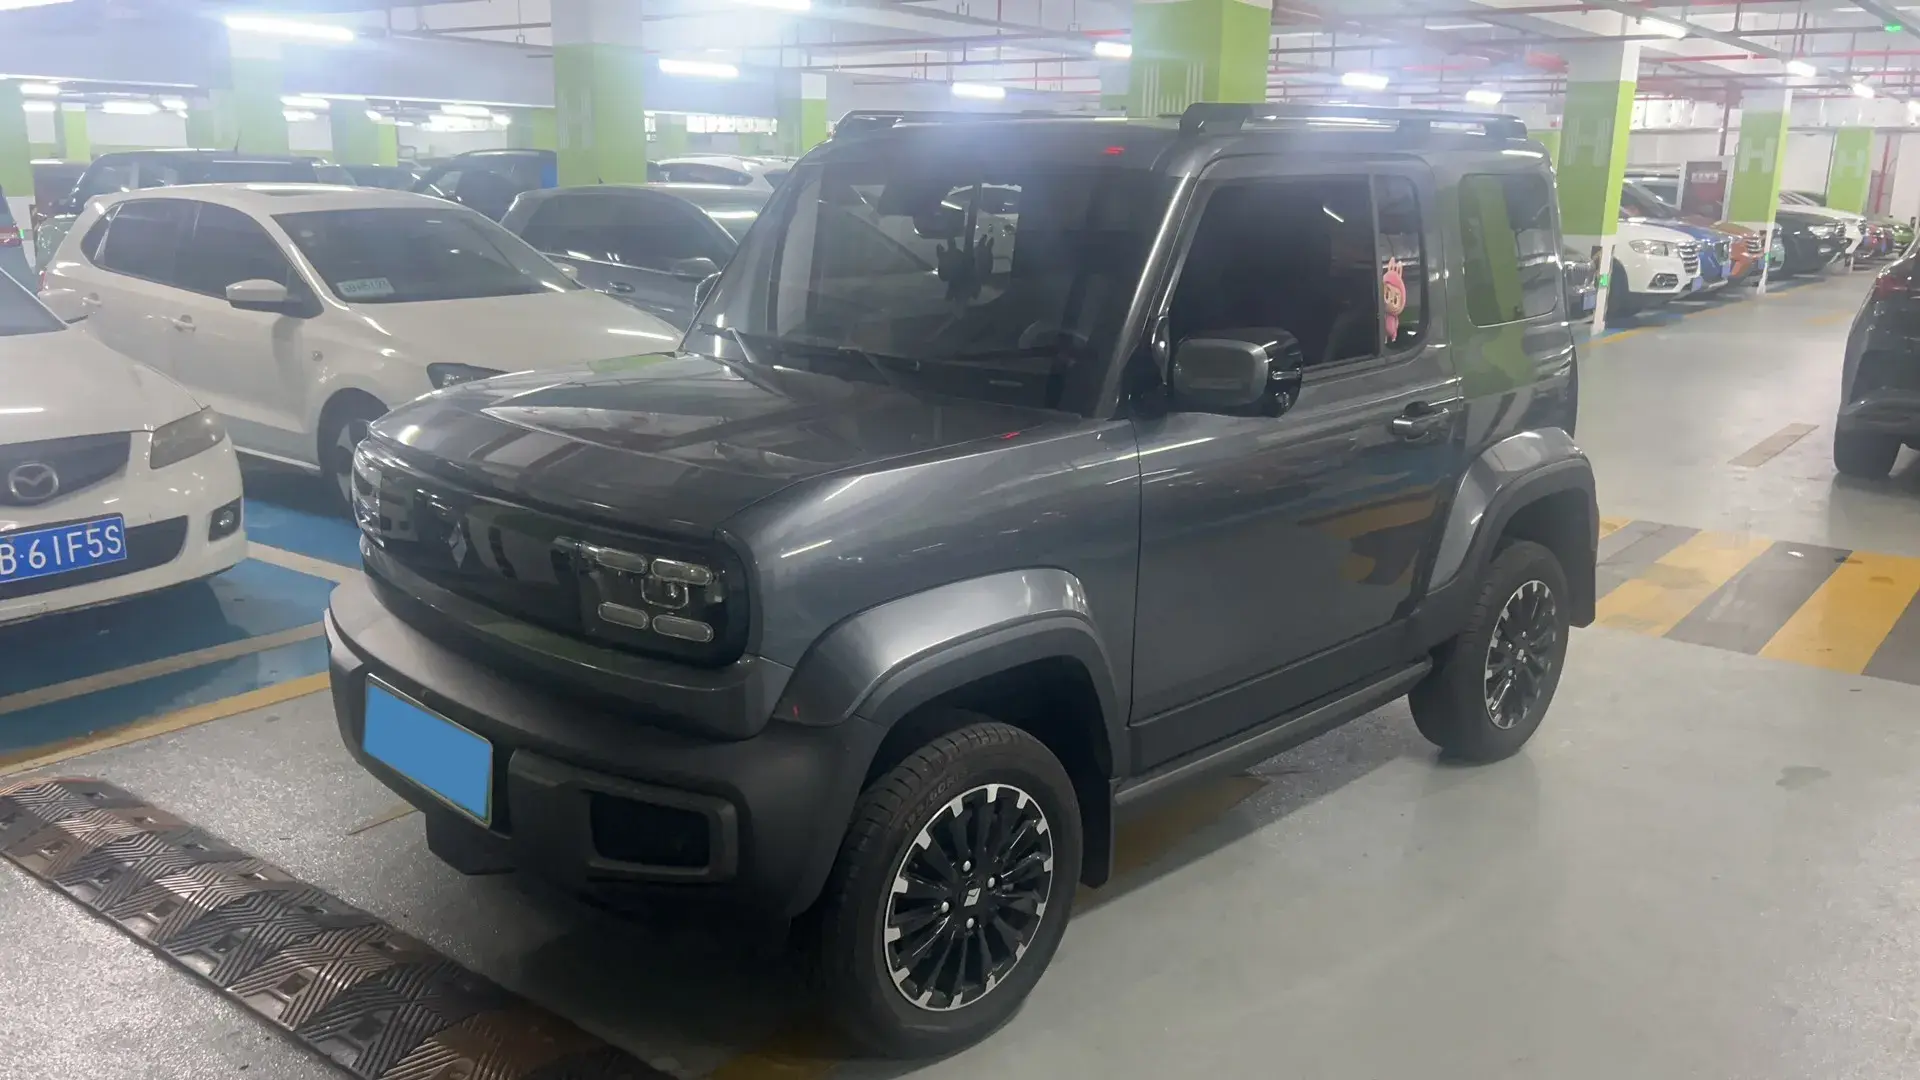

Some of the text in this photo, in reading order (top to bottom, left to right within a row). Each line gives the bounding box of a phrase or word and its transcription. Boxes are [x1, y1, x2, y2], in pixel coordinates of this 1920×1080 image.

[1563, 118, 1611, 167] H
[1738, 137, 1776, 173] H
[1836, 149, 1866, 178] H
